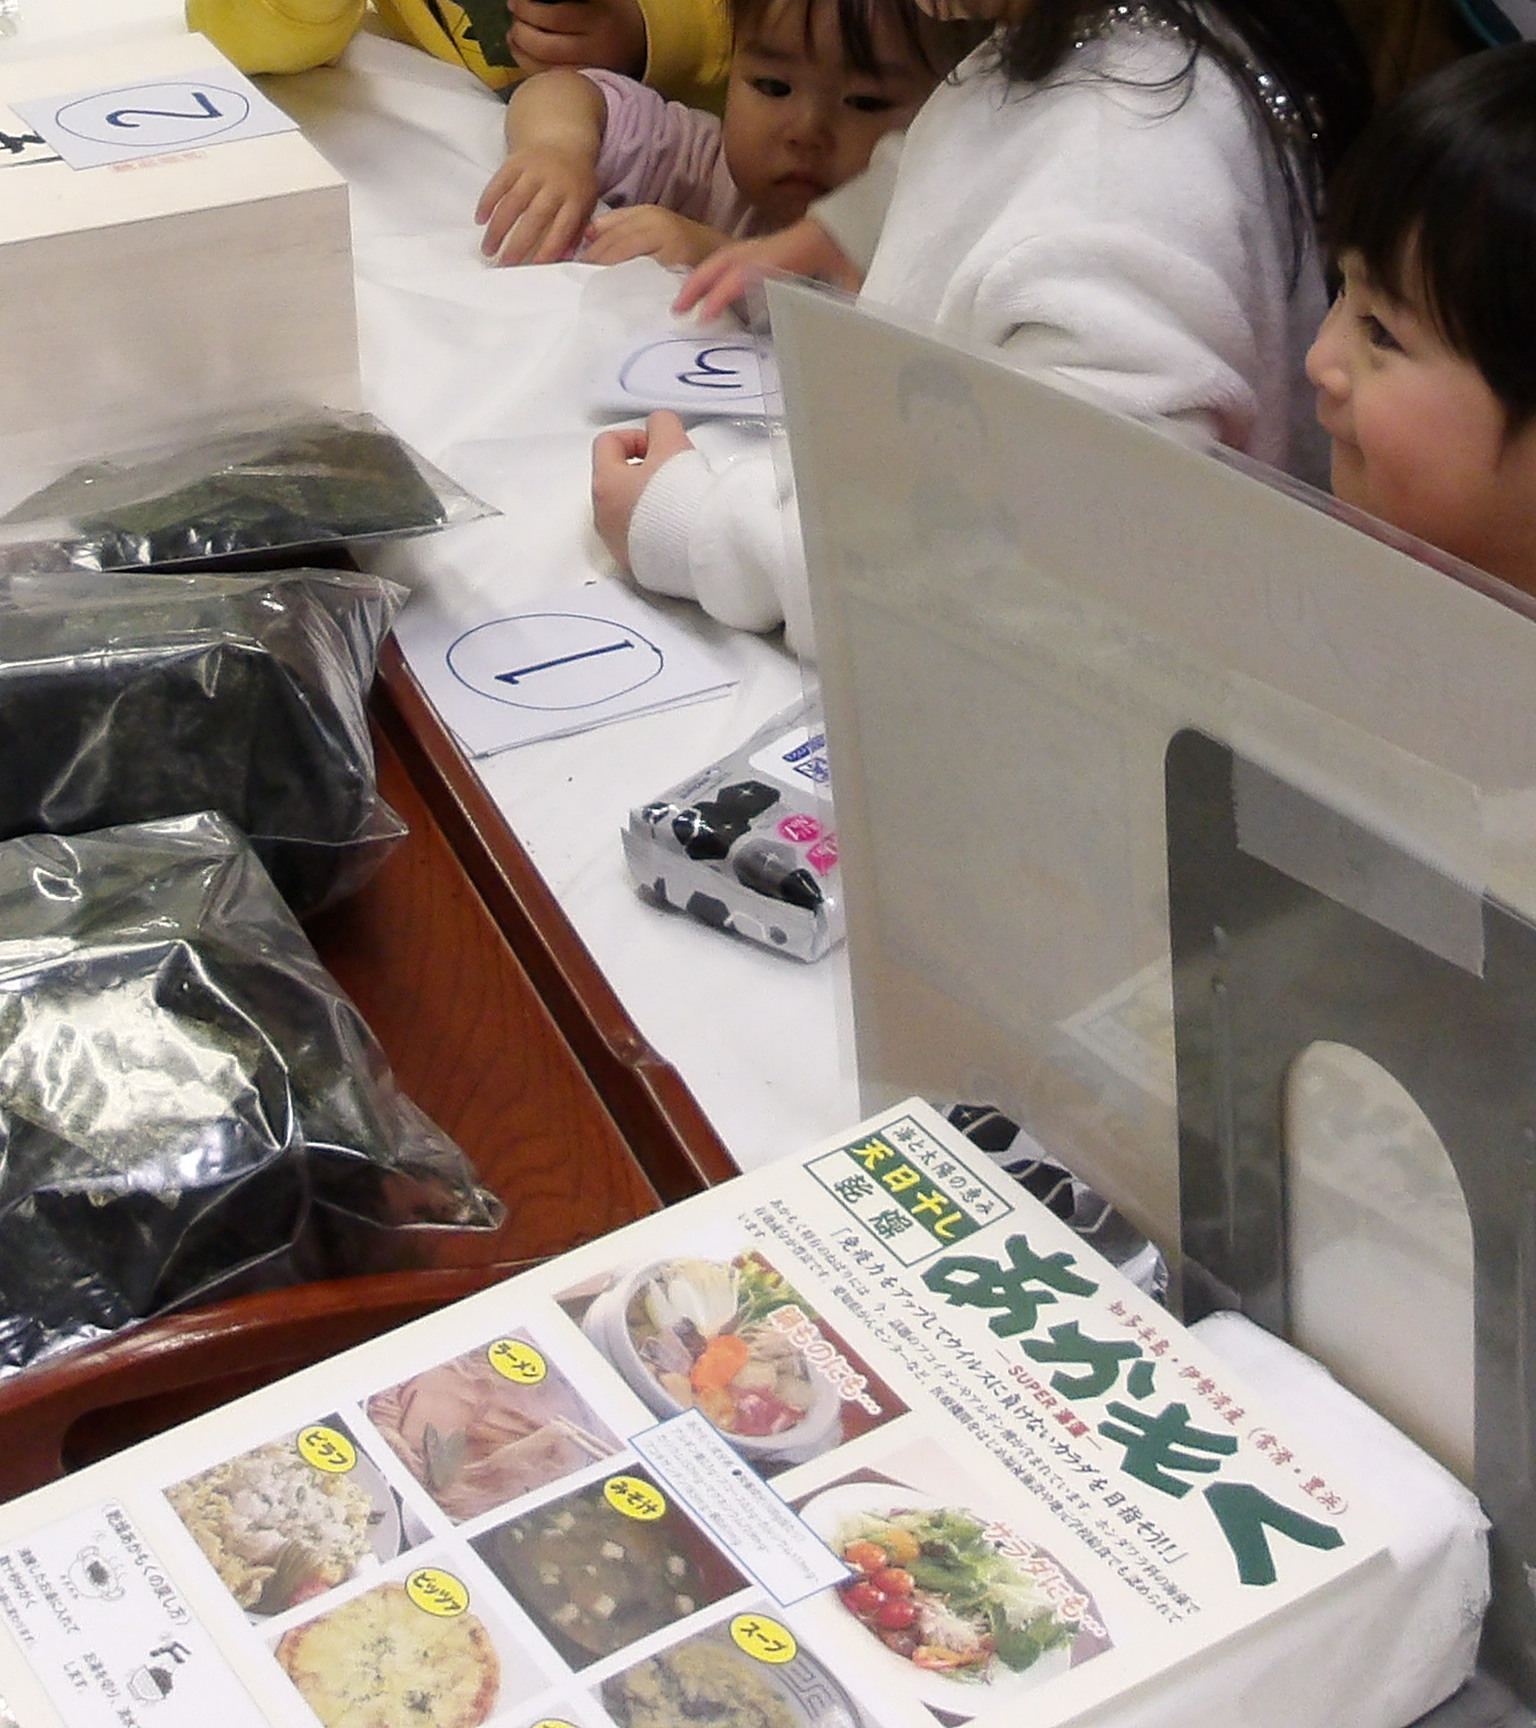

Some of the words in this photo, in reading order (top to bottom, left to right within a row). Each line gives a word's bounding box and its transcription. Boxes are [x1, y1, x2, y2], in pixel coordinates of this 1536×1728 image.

[845, 1135, 976, 1242] 天日干し
[889, 1124, 999, 1218] 海と太陽の恵み
[488, 1340, 545, 1381] ラーメン
[1002, 1363, 1060, 1411] SUPER
[921, 1254, 1345, 1584] あかもく
[608, 1477, 663, 1519] みそ汁
[738, 1619, 788, 1657] スープ
